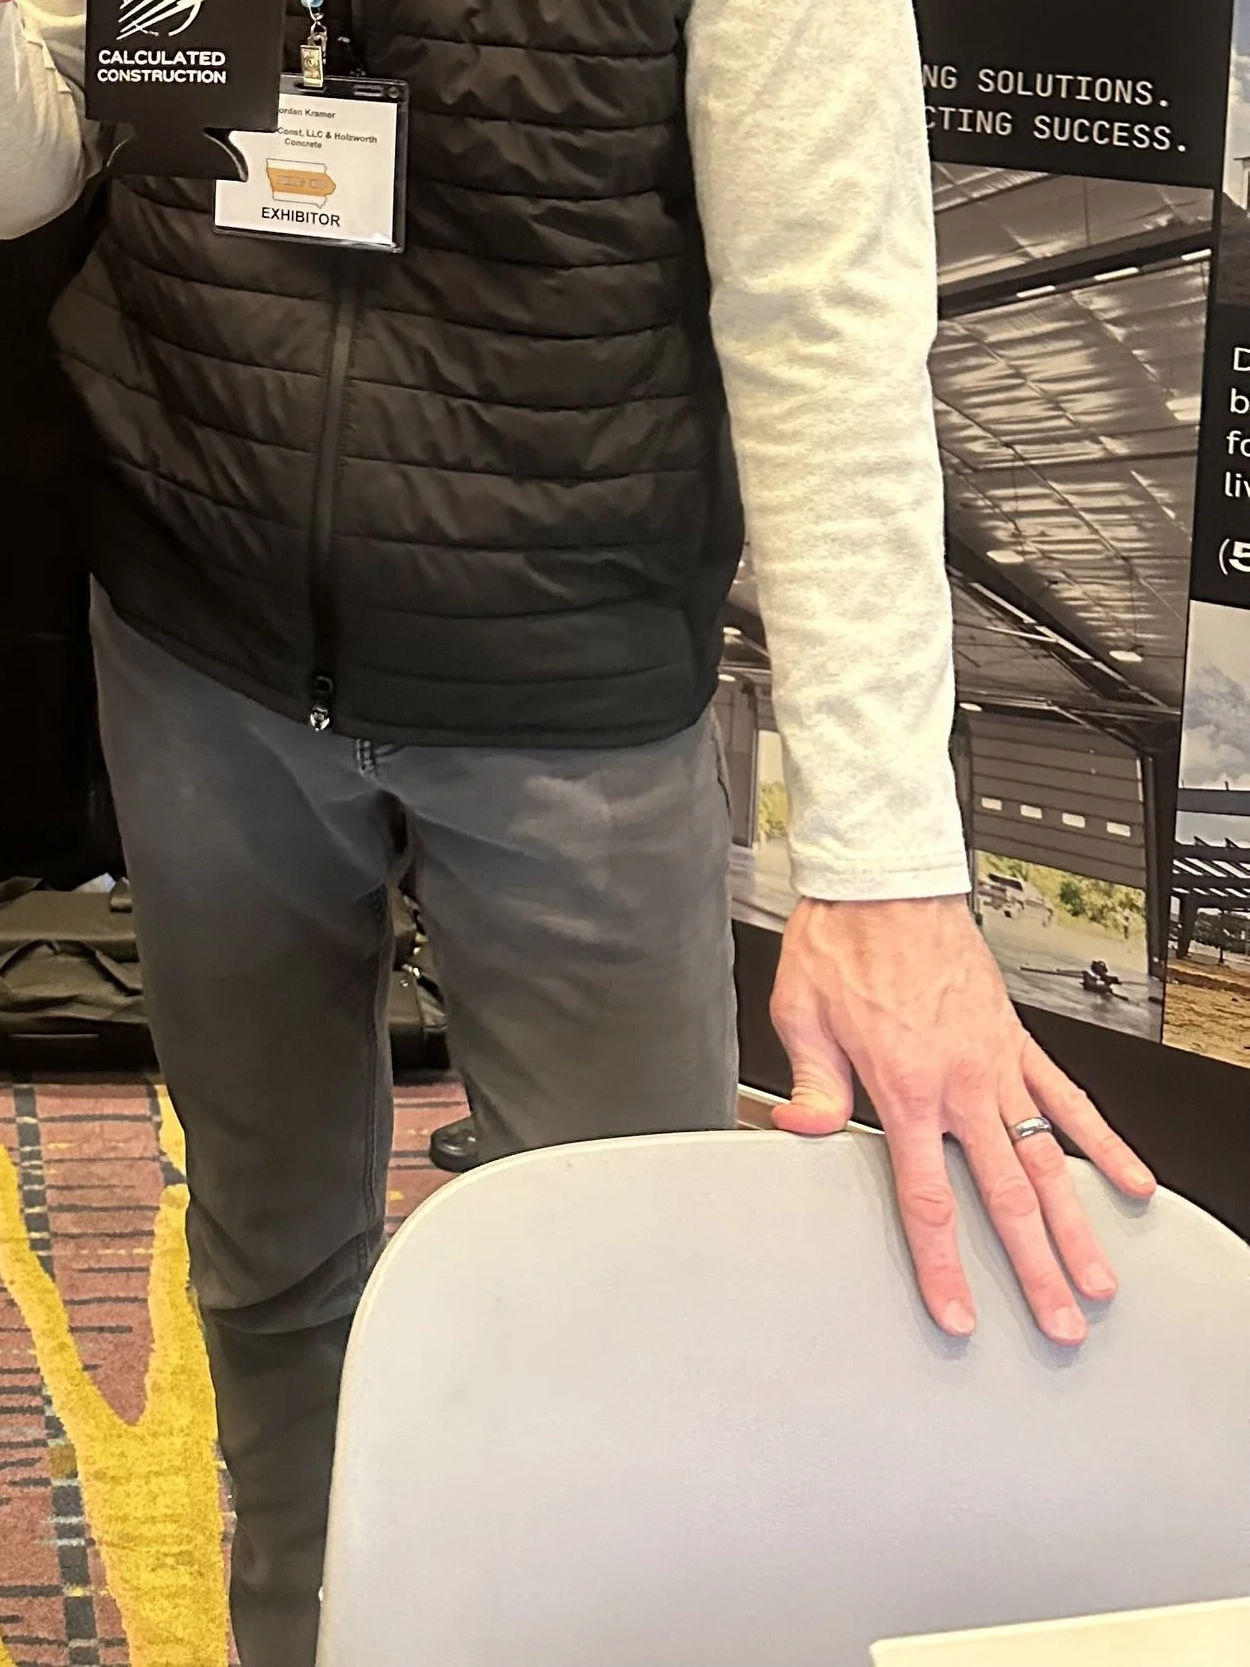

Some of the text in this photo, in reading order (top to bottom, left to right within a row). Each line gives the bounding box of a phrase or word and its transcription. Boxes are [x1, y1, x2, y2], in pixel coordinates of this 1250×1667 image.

[98, 49, 226, 66] CALCULATED
[97, 68, 227, 83] CONSTRUCTION
[978, 68, 1169, 107] SOLUTIONS.
[305, 109, 336, 119] Kramer
[306, 130, 323, 139] LLC
[325, 131, 332, 139] &
[334, 133, 378, 144] Holzworth
[1033, 115, 1187, 152] SUCCESS.
[285, 138, 322, 149] Concrete
[261, 207, 341, 227] EXHIBITOR
